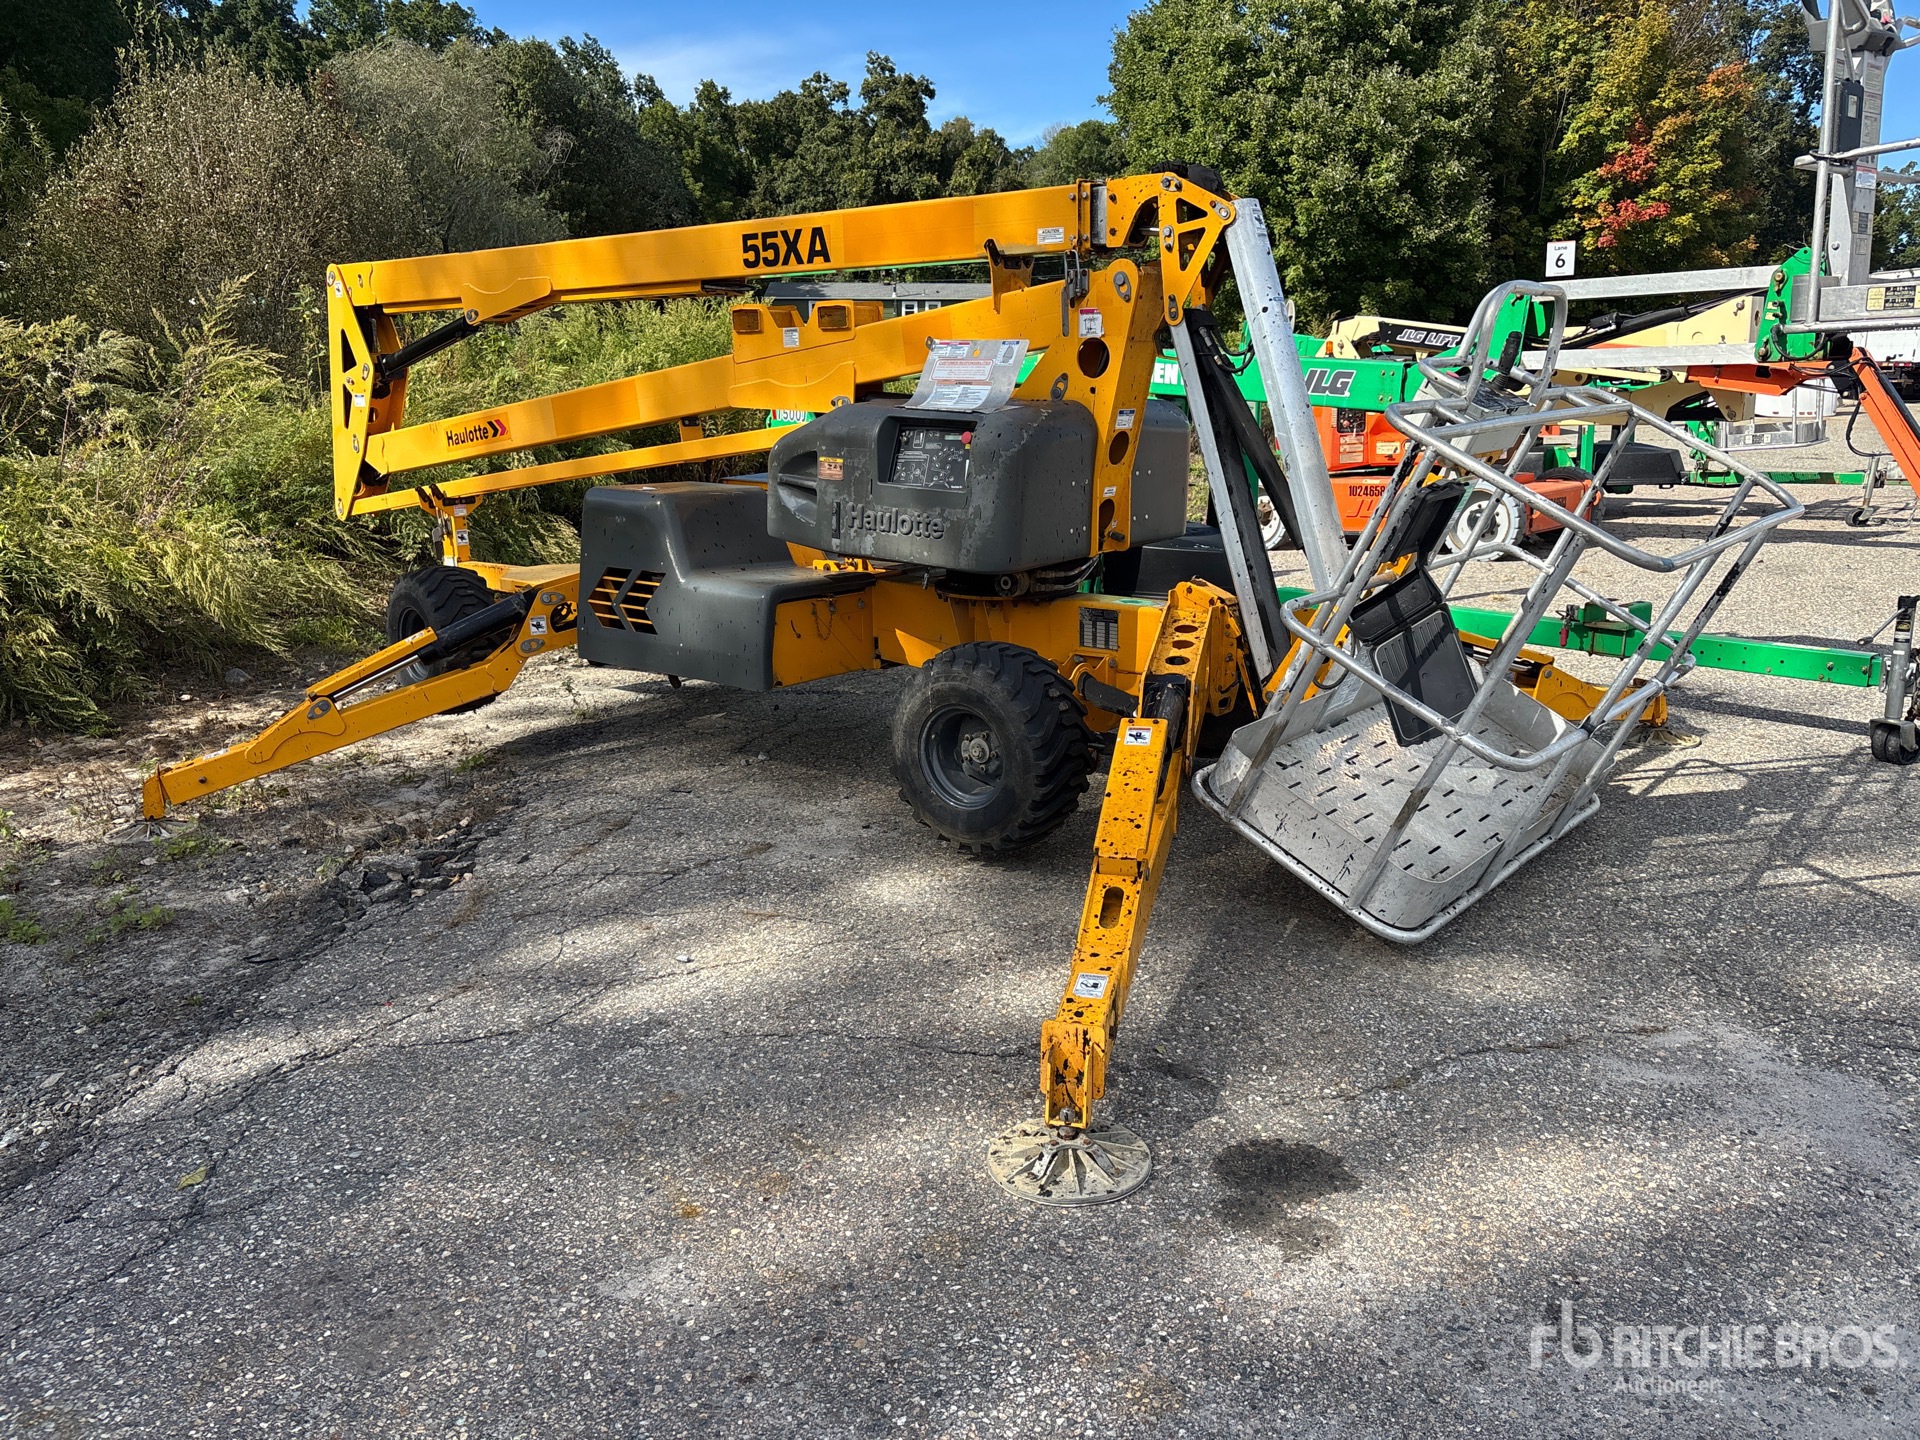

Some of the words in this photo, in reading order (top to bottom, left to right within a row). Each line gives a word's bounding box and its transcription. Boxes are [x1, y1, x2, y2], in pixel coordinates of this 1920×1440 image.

[742, 226, 831, 269] 55XA
[1555, 253, 1566, 268] 6
[1396, 329, 1427, 343] JLG
[1424, 332, 1461, 347] LIFT
[446, 424, 489, 447] Haulotte
[847, 501, 945, 540] Haulotte
